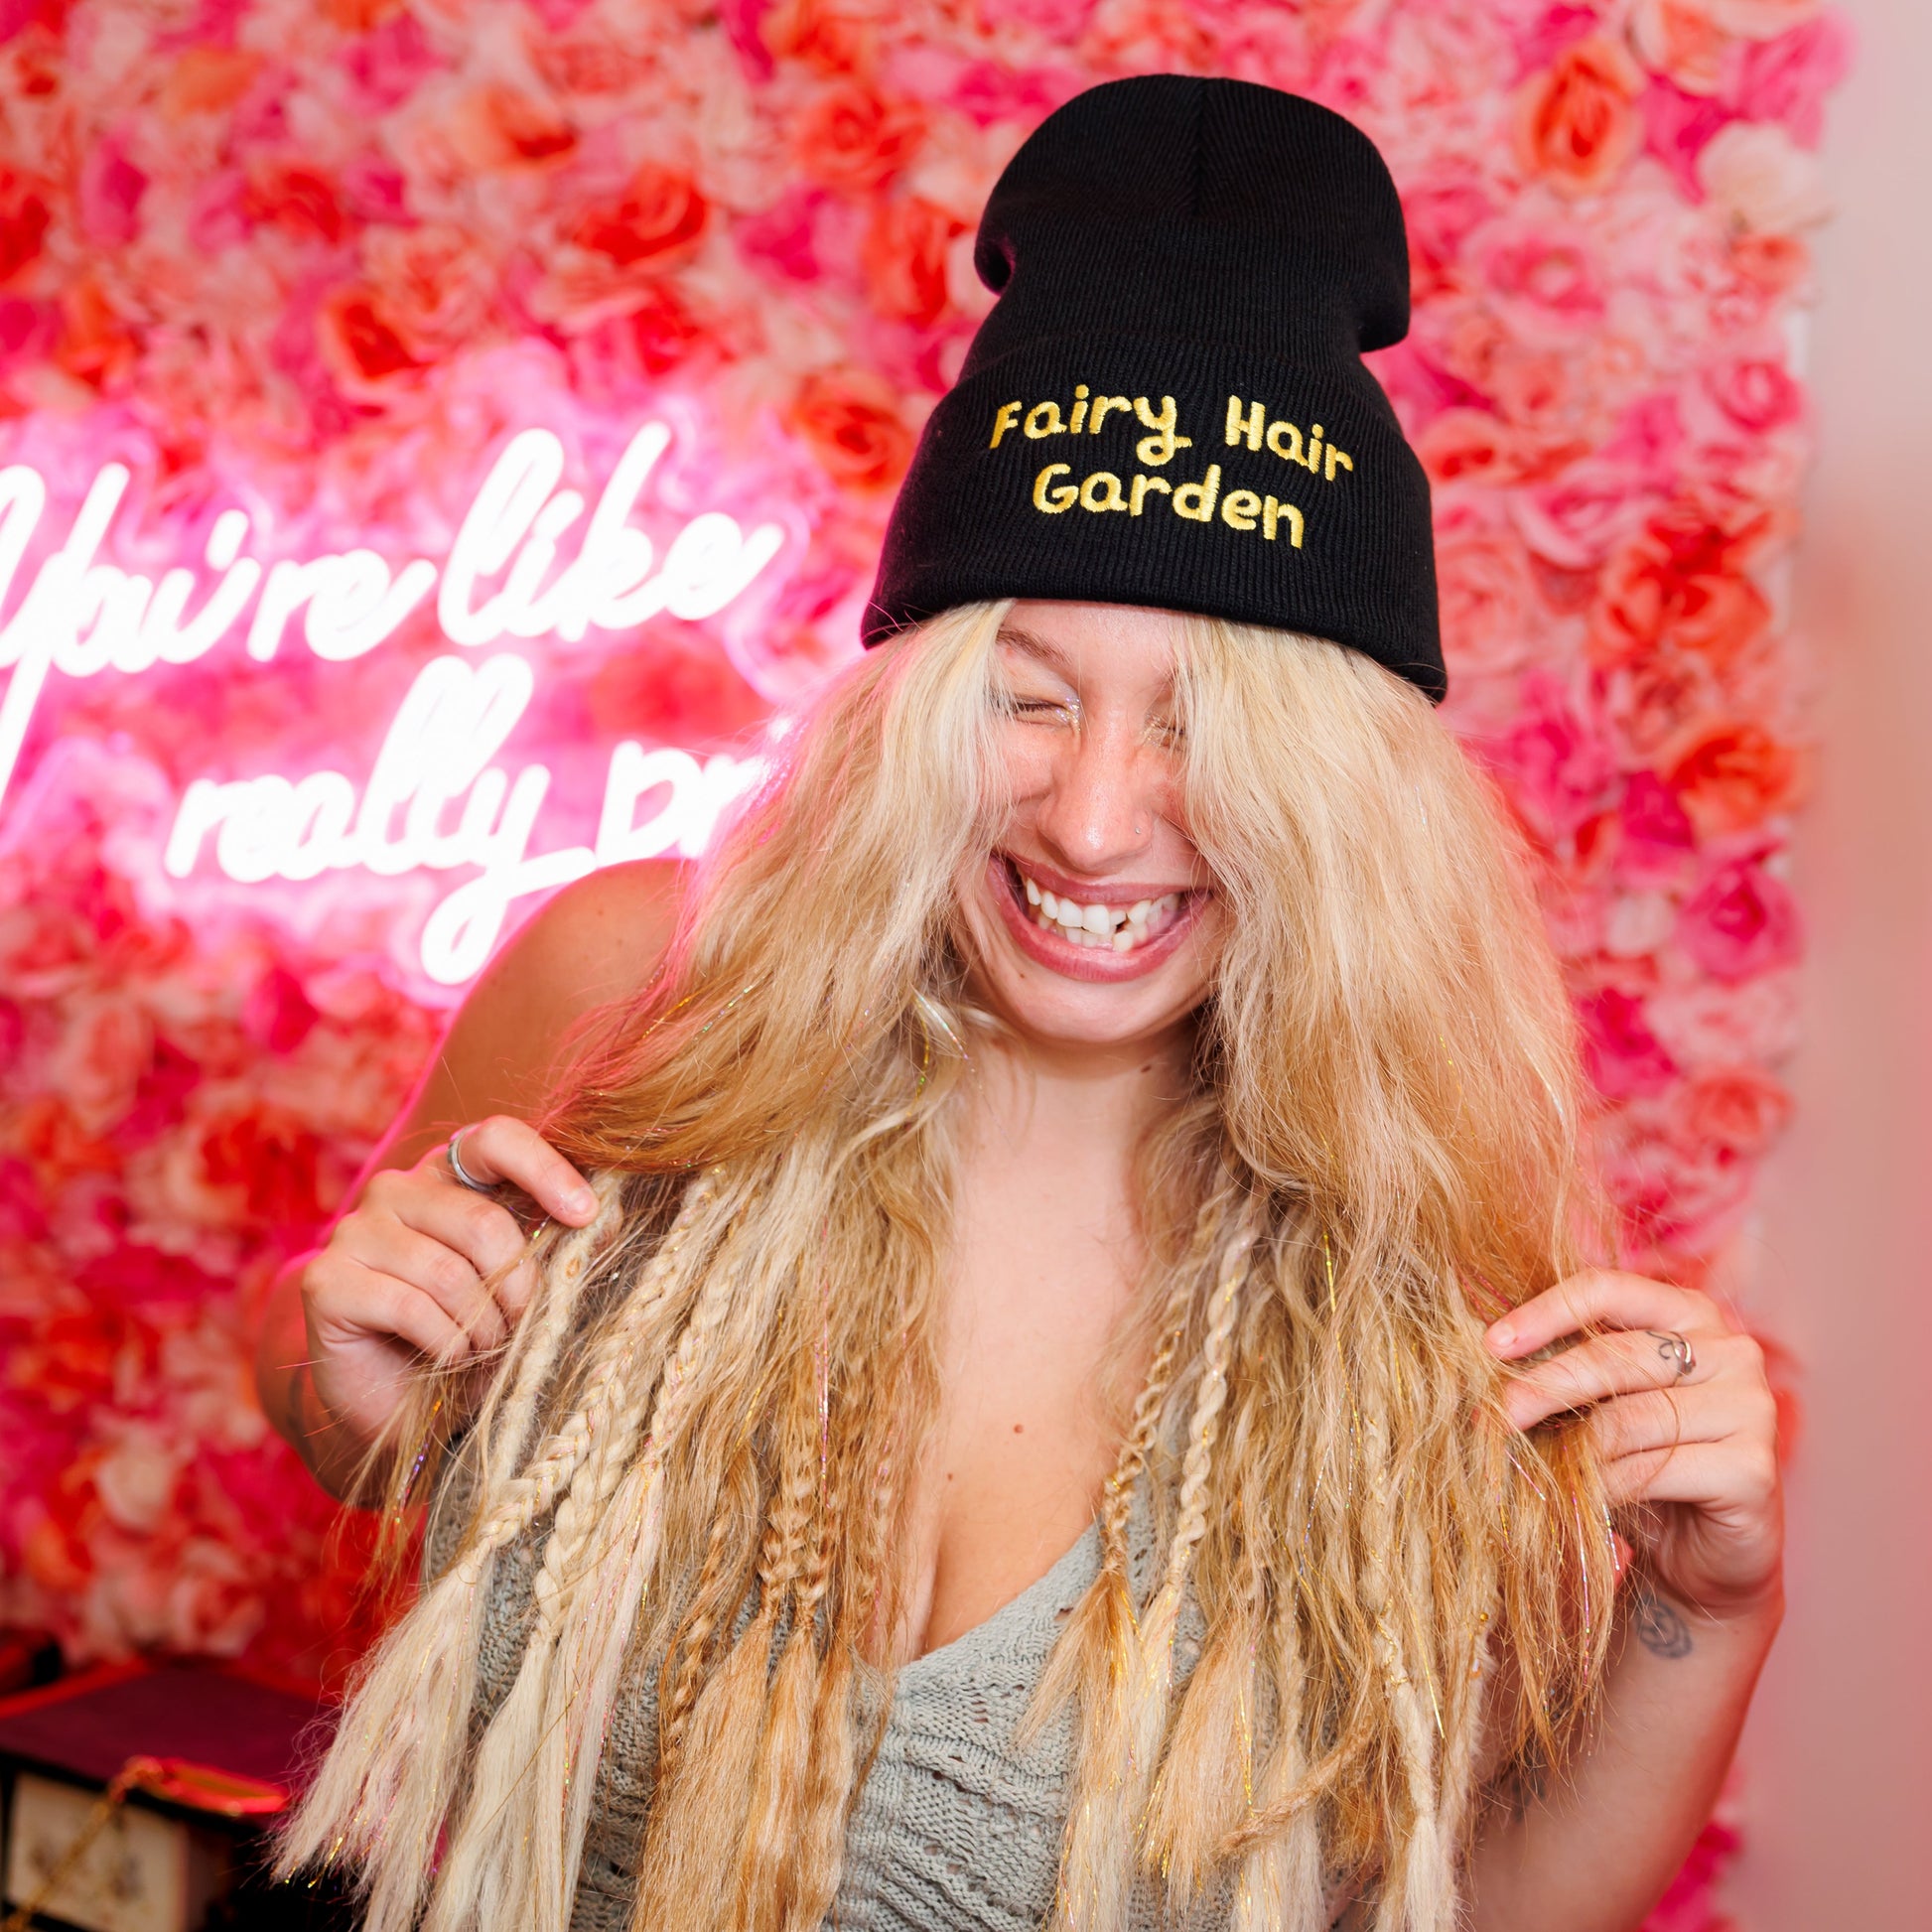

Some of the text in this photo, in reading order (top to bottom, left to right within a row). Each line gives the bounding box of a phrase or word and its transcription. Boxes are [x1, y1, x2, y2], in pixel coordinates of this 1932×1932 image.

[990, 384, 1353, 482] Fairy Hair
[1033, 463, 1305, 549] Garden
[0, 423, 785, 799] You're like
[165, 655, 598, 985] really
